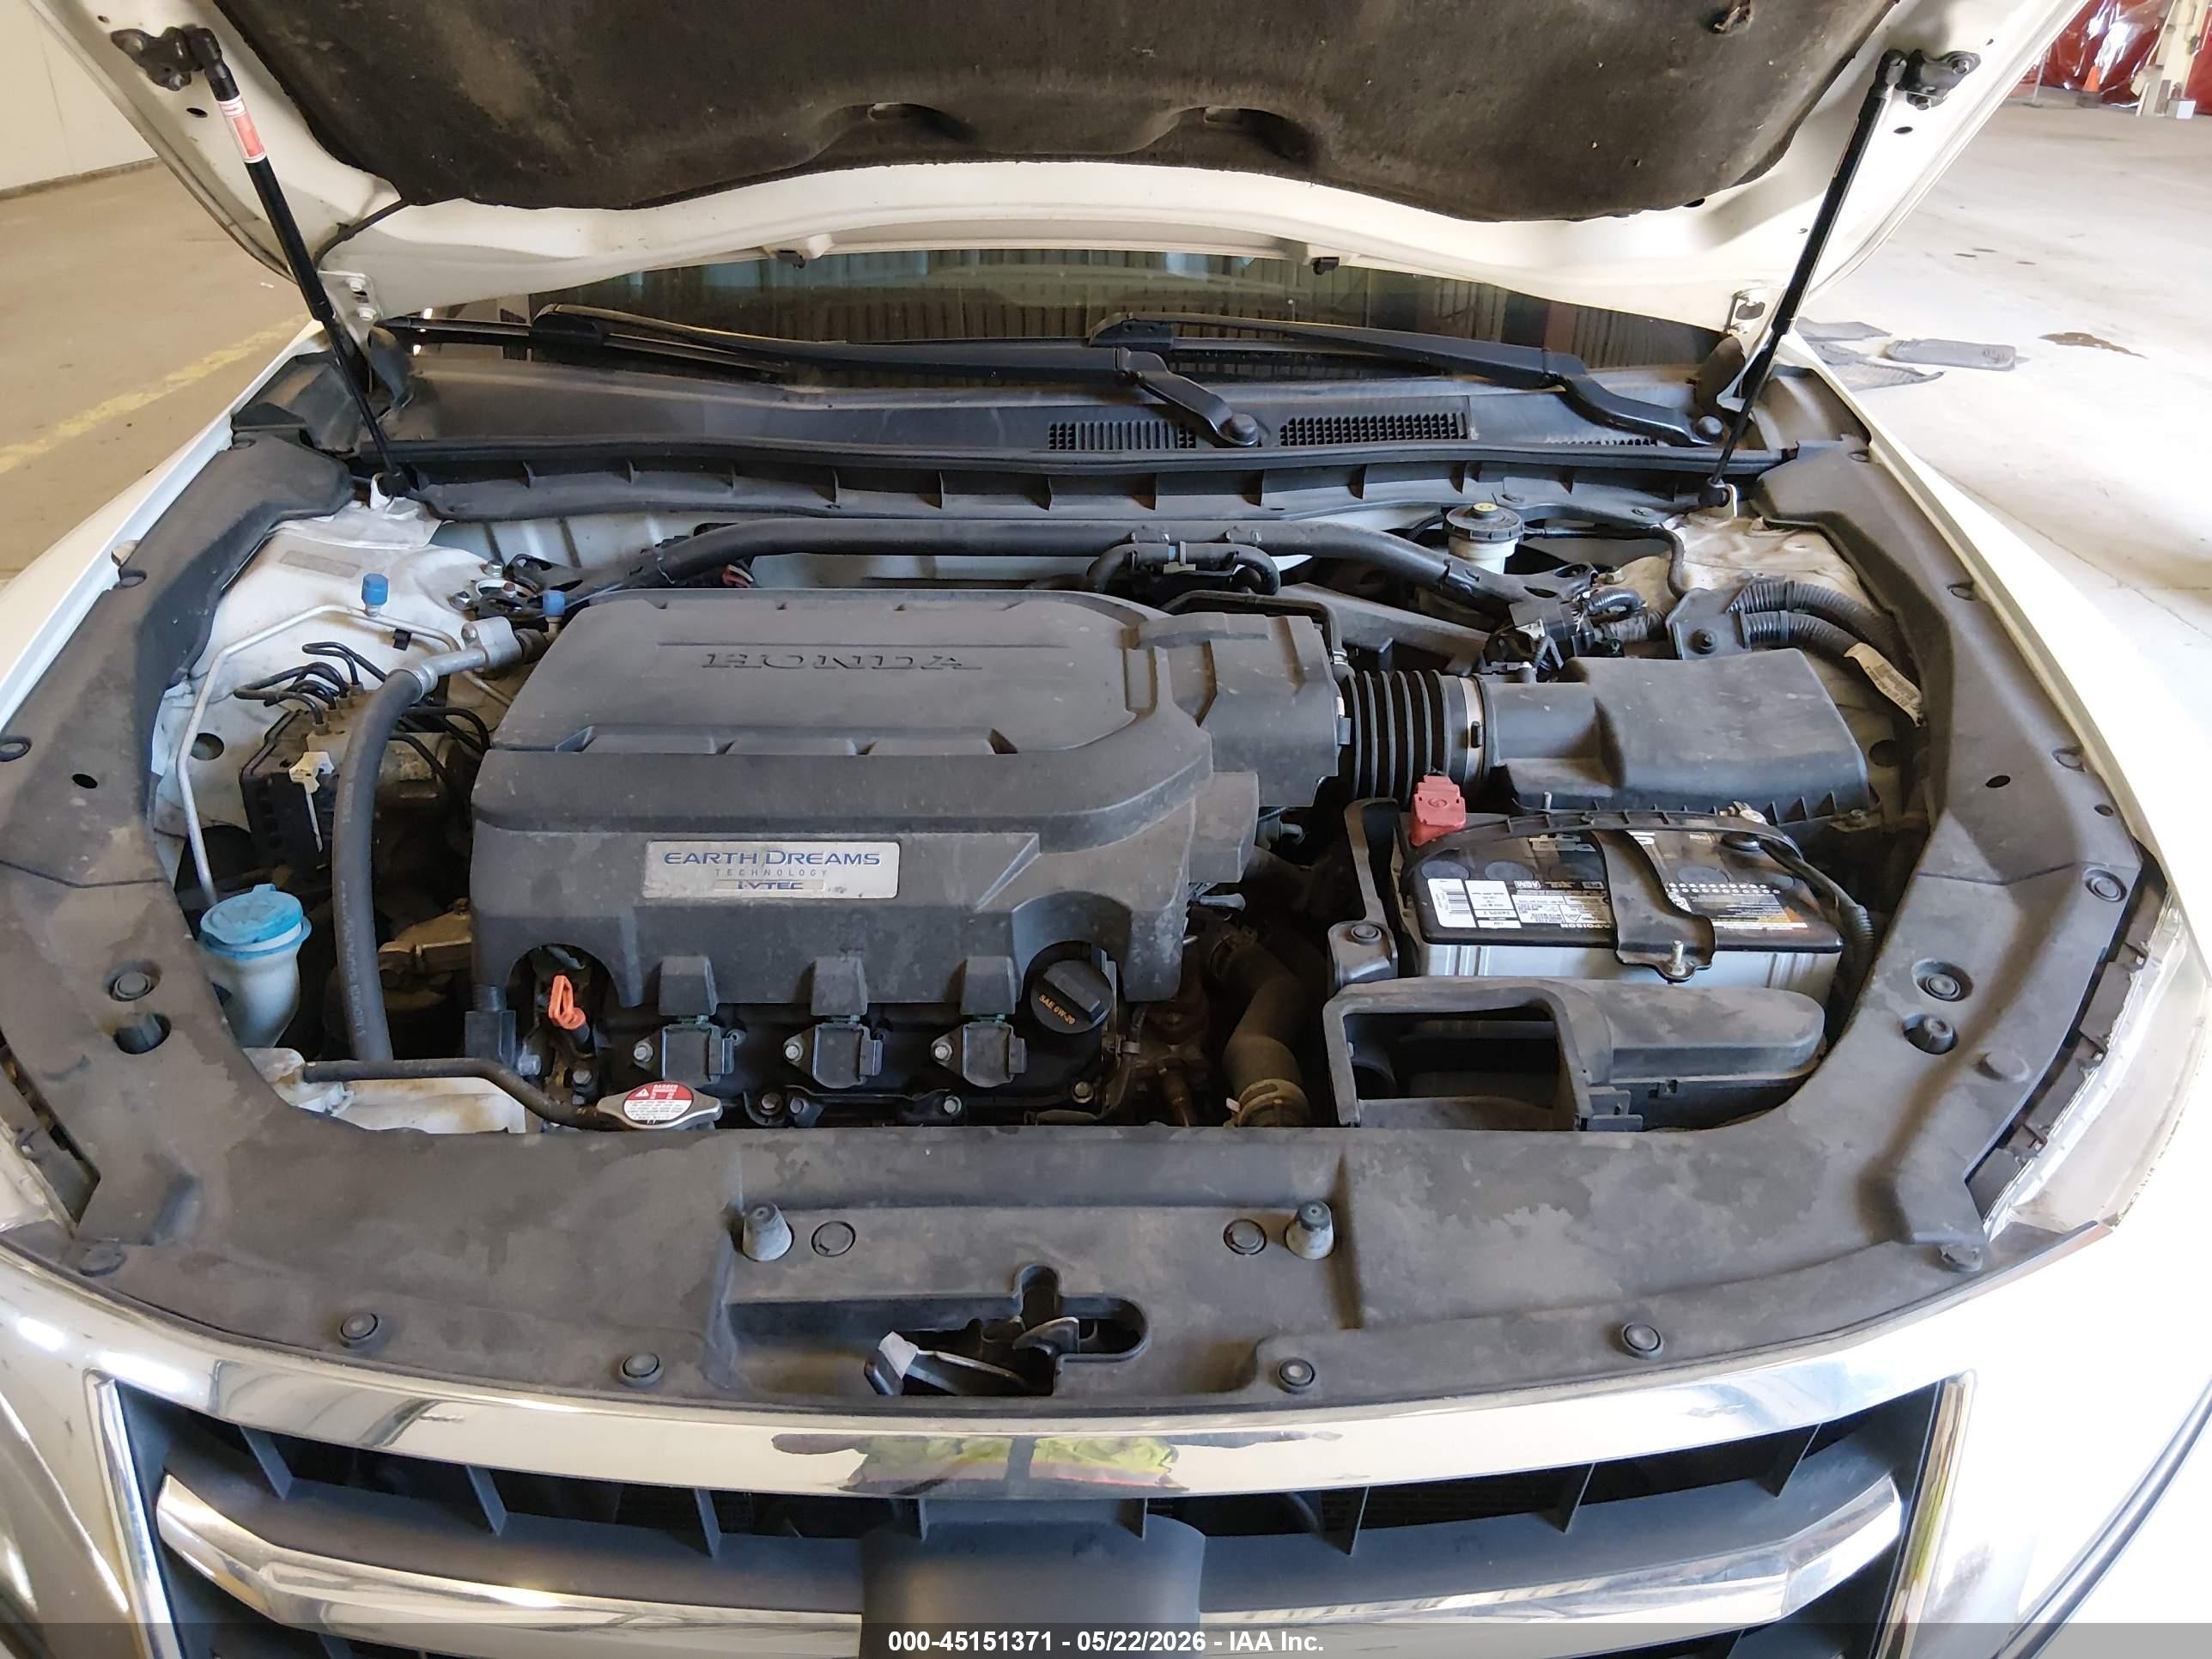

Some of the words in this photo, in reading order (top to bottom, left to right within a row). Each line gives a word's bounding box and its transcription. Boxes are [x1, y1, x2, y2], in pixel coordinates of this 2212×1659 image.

[702, 653, 982, 670] HONDA
[664, 852, 757, 865] EARTH
[714, 868, 828, 877] TECHNOLOGY
[1039, 995, 1054, 1009] SAE
[1054, 1006, 1076, 1024] 0W-20
